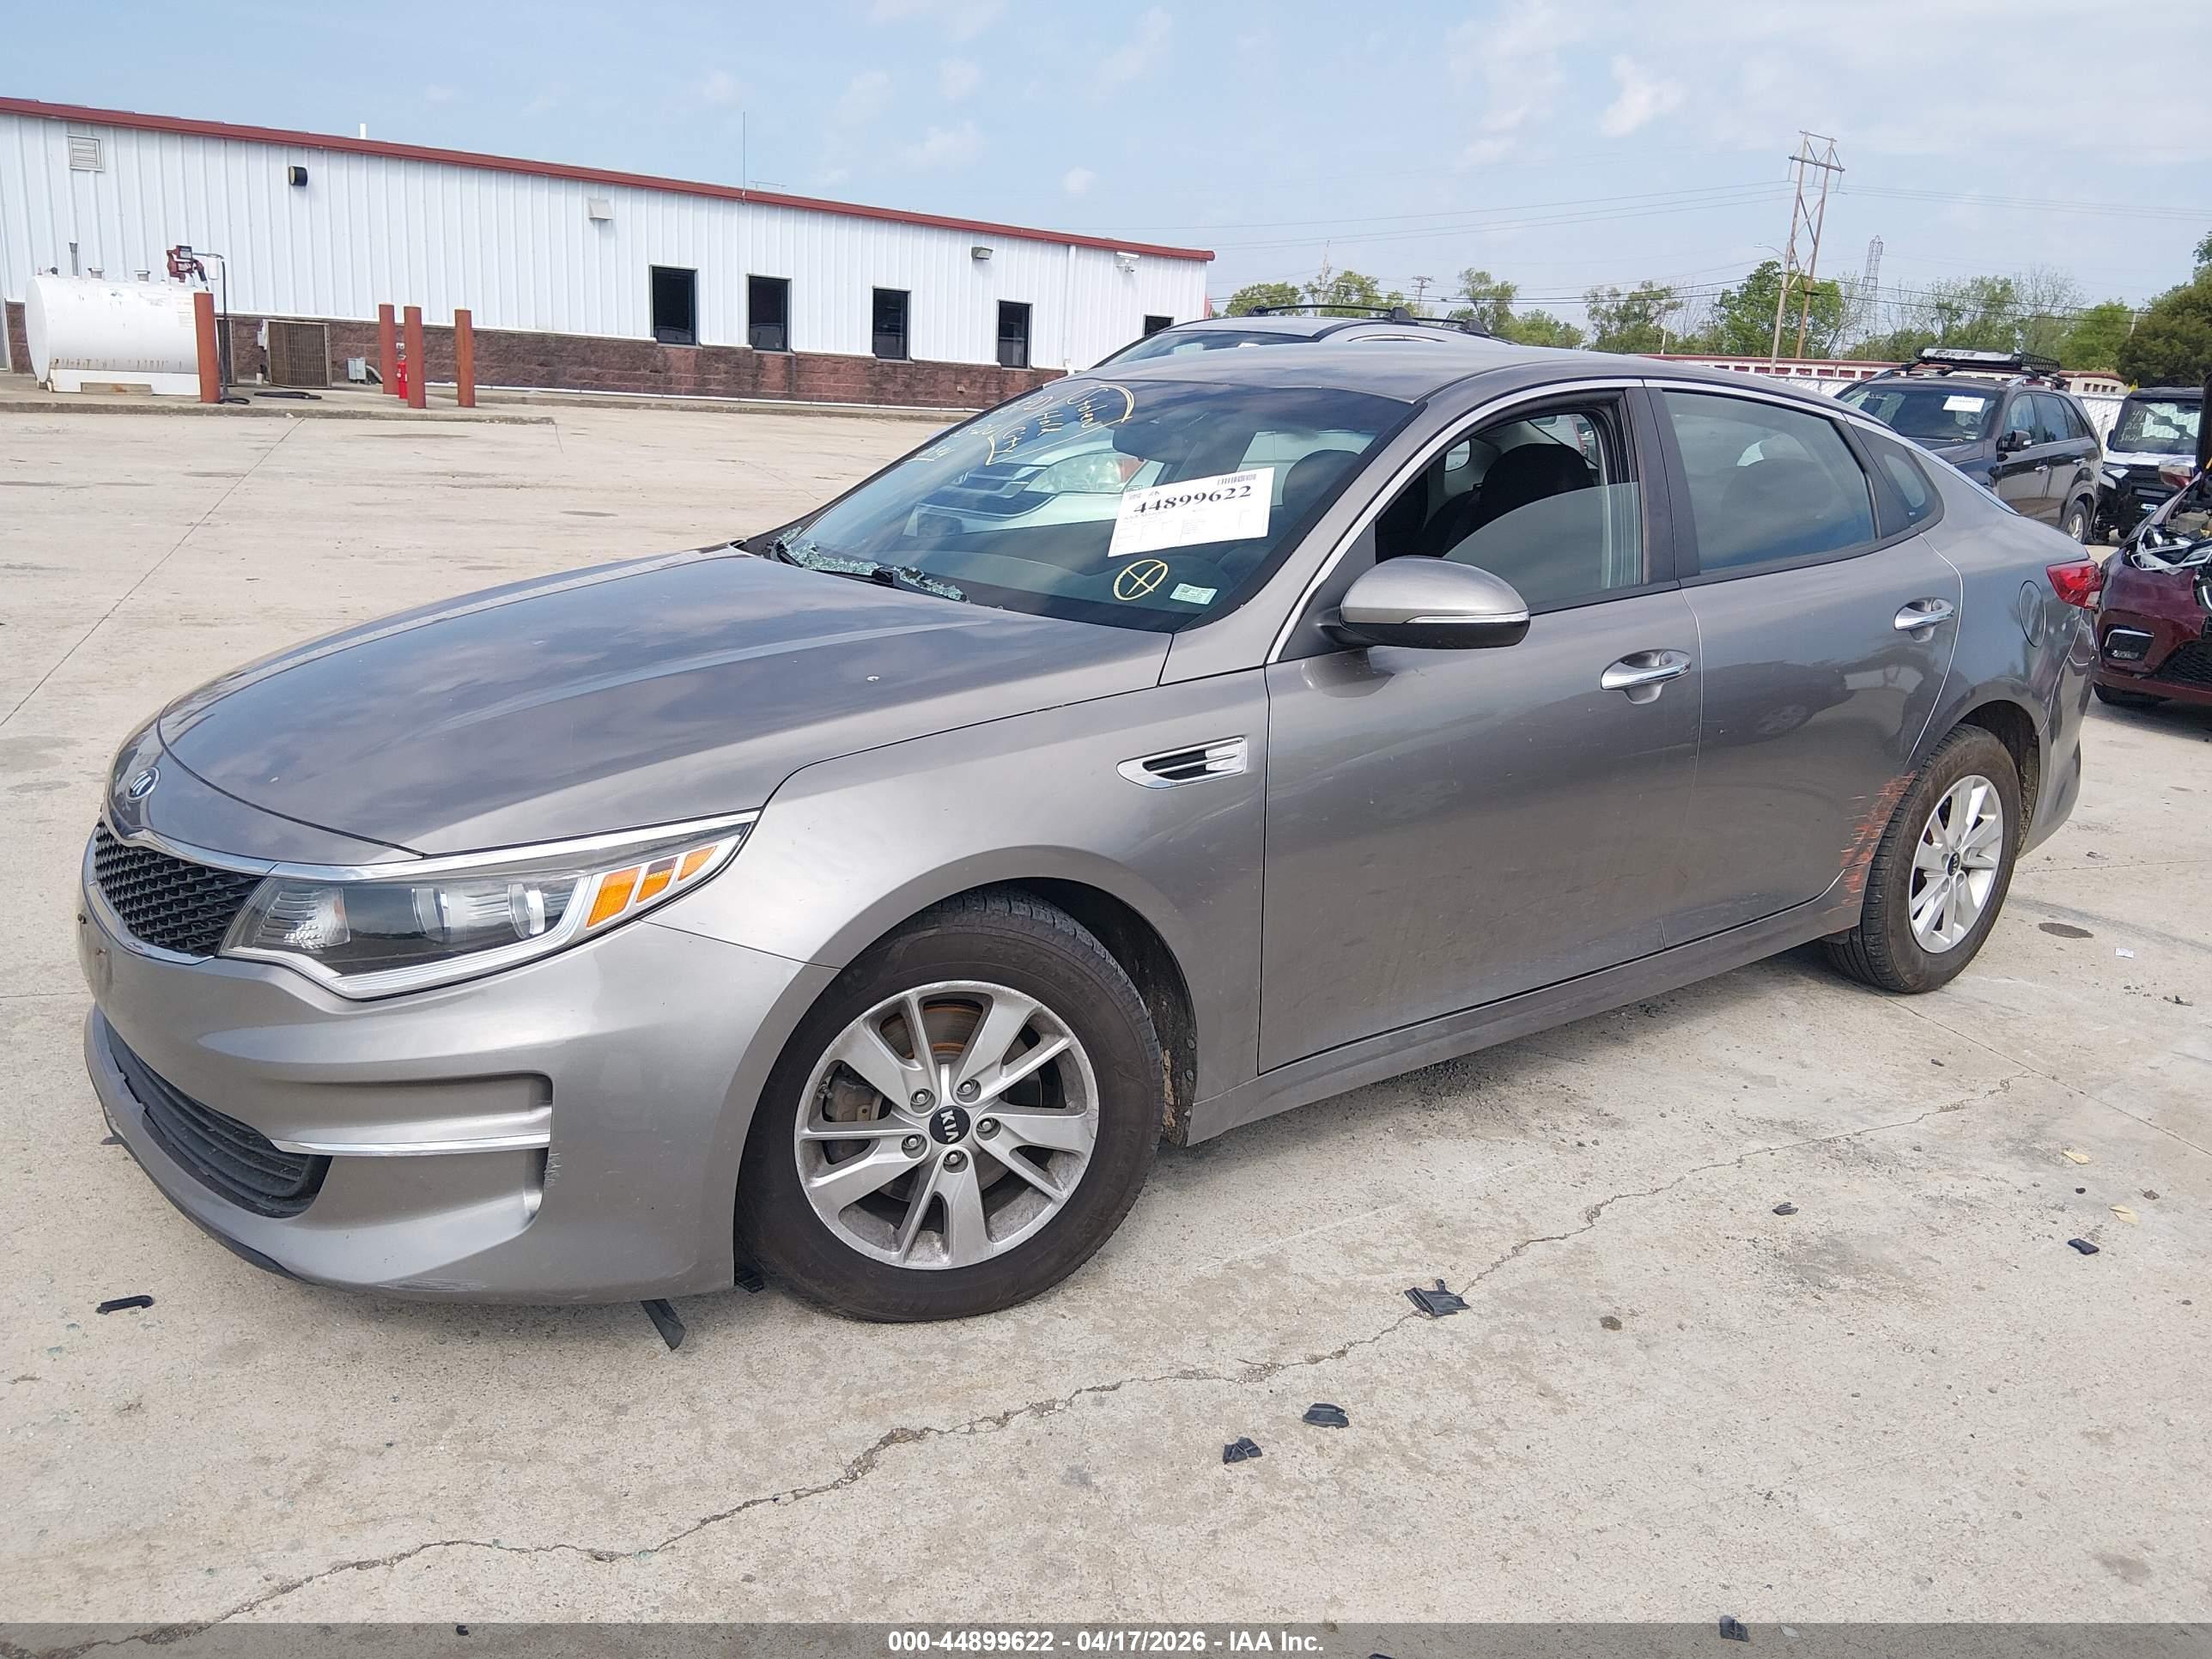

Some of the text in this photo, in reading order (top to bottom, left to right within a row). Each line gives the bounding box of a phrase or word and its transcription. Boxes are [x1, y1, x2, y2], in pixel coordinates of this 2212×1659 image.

[1036, 410, 1064, 436] Hold
[1133, 485, 1252, 514] 44899622
[940, 1109, 959, 1142] KIA
